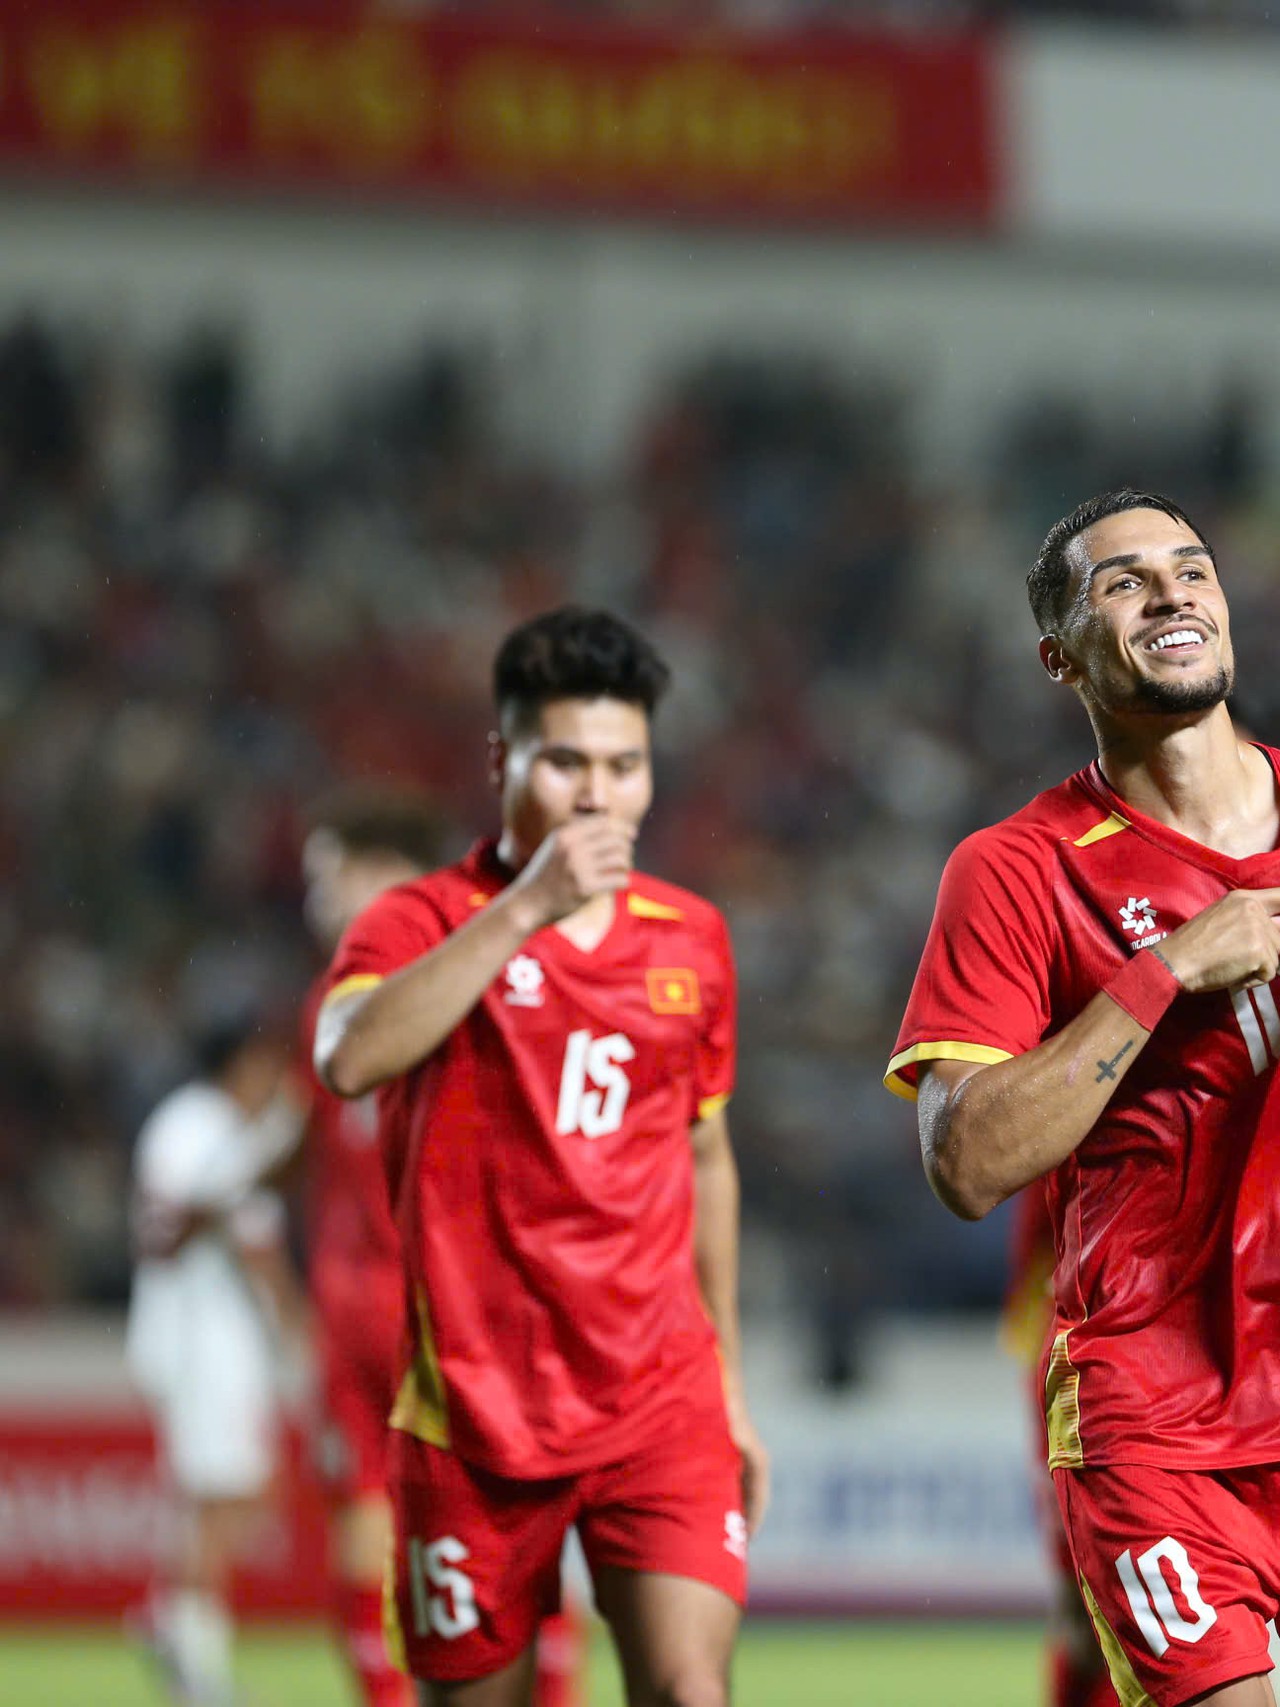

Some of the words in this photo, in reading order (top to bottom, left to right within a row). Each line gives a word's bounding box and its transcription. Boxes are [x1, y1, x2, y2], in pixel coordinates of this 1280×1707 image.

[555, 1029, 635, 1138] 15
[408, 1536, 479, 1638] 15
[1115, 1535, 1218, 1658] 10
